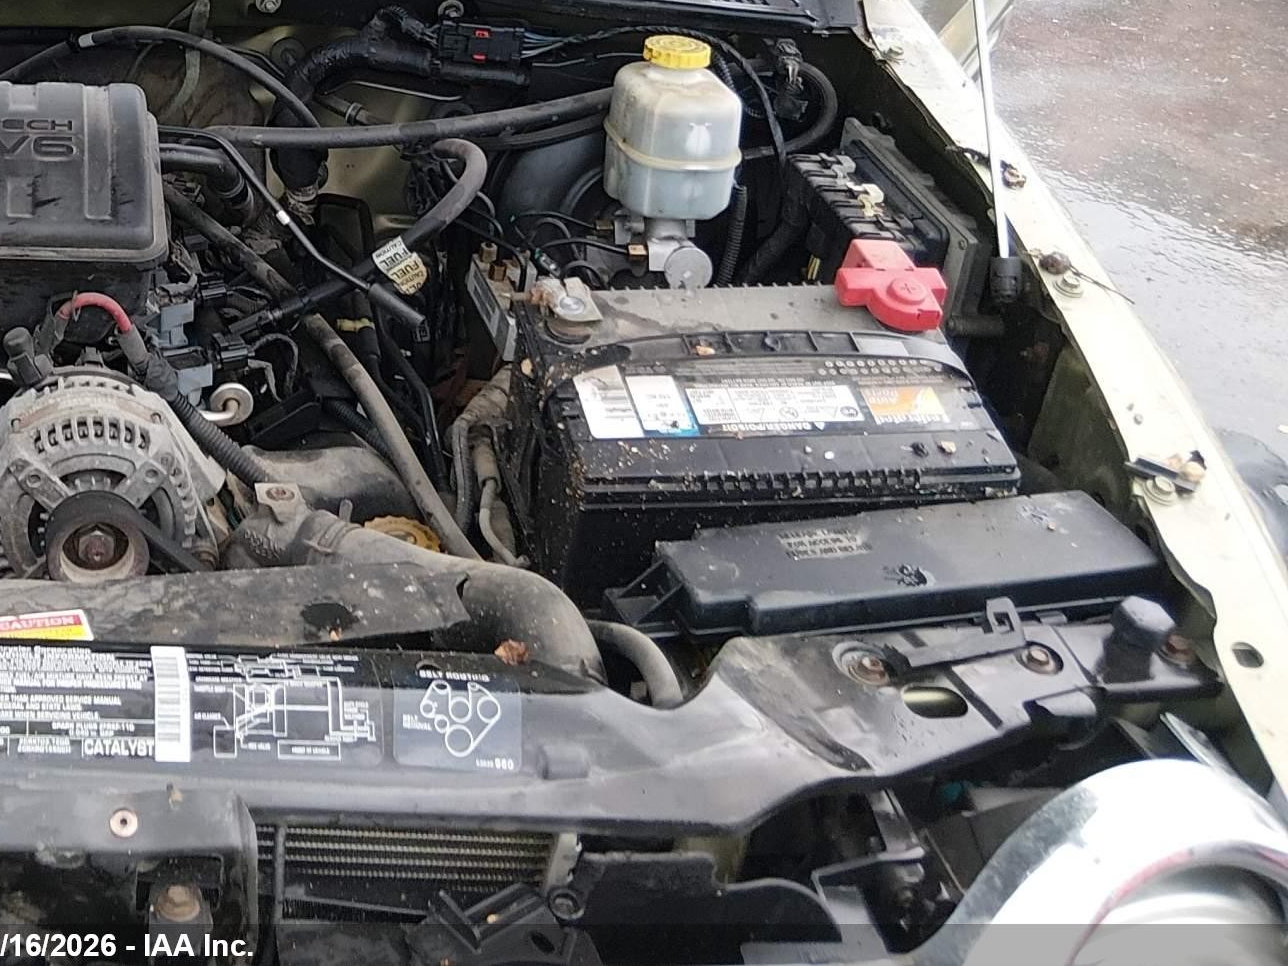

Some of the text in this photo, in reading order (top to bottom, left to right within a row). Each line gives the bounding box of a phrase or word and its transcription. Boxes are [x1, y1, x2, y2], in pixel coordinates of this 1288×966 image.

[376, 240, 402, 258] CAUTION
[379, 247, 409, 267] FUEL
[390, 260, 420, 279] FUEL
[0, 616, 75, 632] CAUTION
[419, 669, 490, 683] BELT ROUTING
[85, 738, 155, 757] CATALYST
